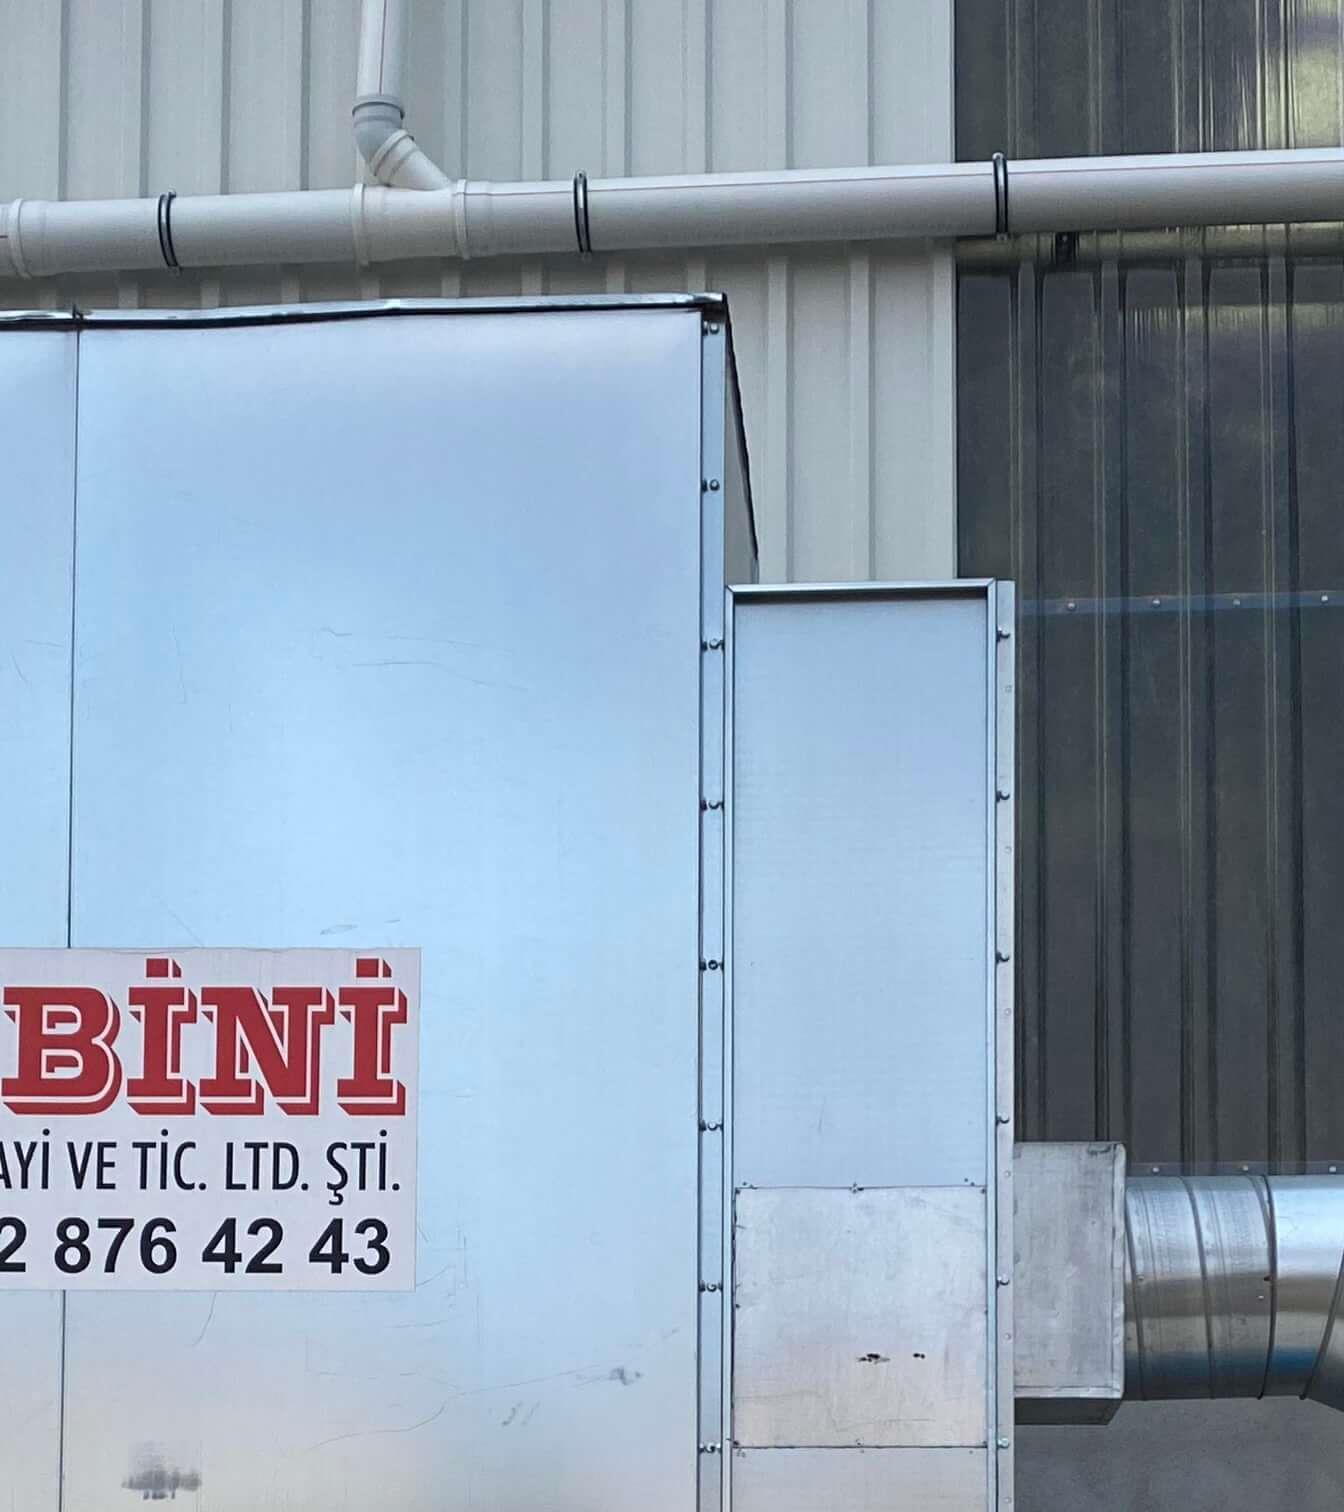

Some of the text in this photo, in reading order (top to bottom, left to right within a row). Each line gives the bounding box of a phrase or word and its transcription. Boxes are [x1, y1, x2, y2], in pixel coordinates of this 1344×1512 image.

[66, 1141, 117, 1190] VE
[132, 1128, 207, 1191] TİC.
[225, 1142, 309, 1191] LTD.
[326, 1129, 400, 1206] ŞTİ.
[54, 1217, 177, 1274] 876
[201, 1217, 284, 1274] 42
[308, 1218, 391, 1275] 43
